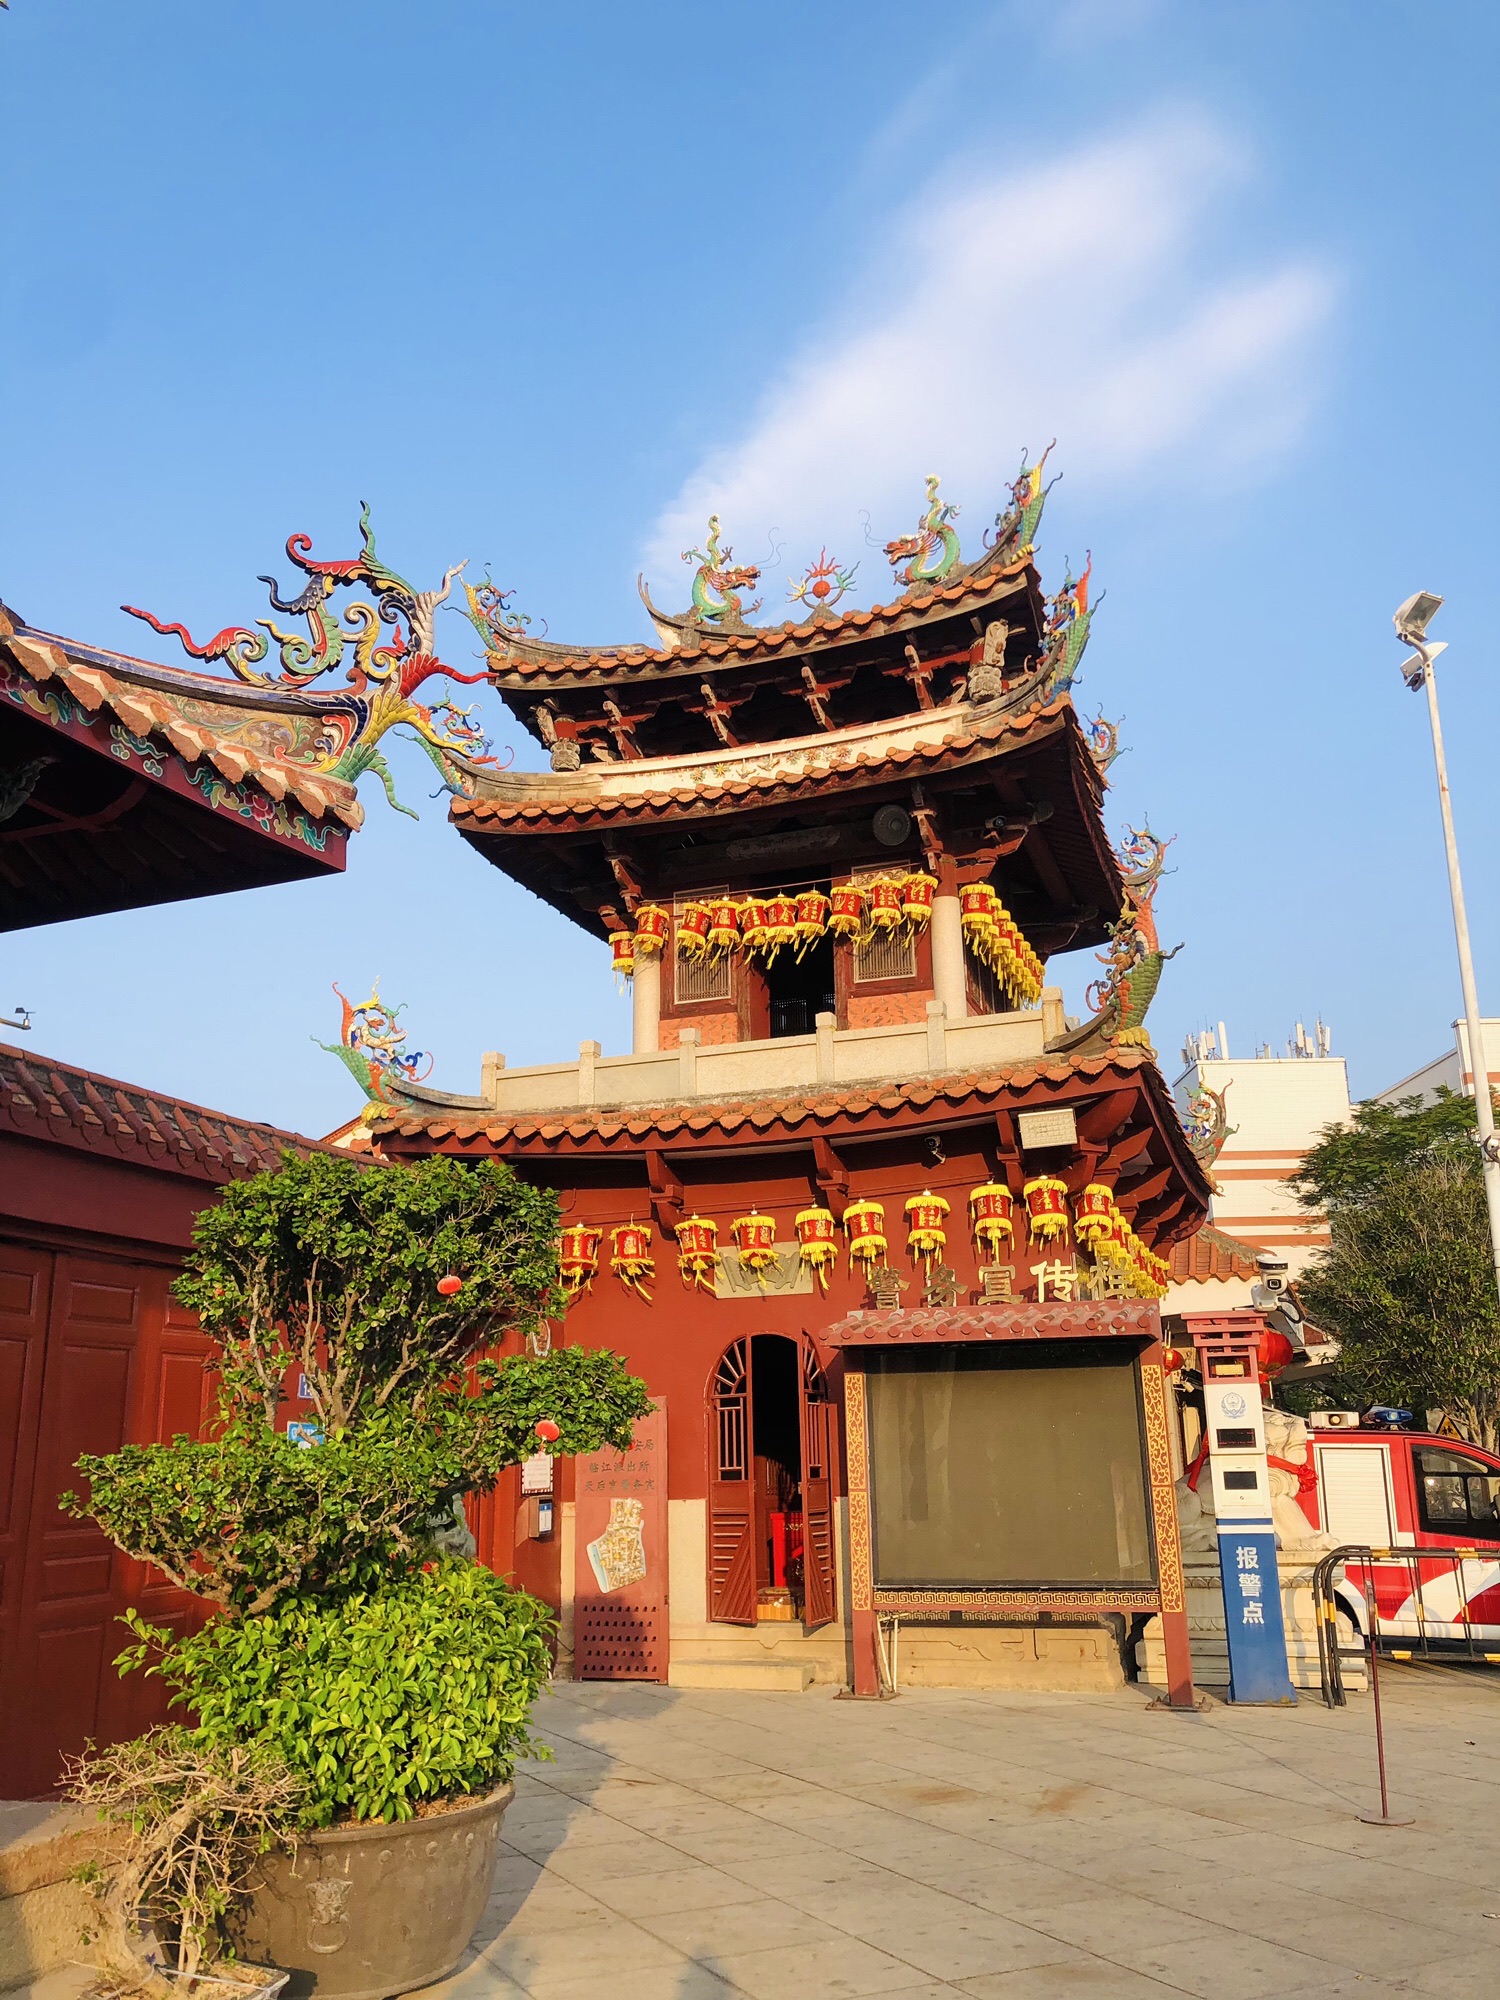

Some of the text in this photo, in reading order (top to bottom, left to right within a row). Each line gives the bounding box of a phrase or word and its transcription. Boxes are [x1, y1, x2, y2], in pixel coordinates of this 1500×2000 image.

[866, 1258, 1137, 1310] 警务宣传栏
[1236, 1546, 1264, 1624] 报警点
